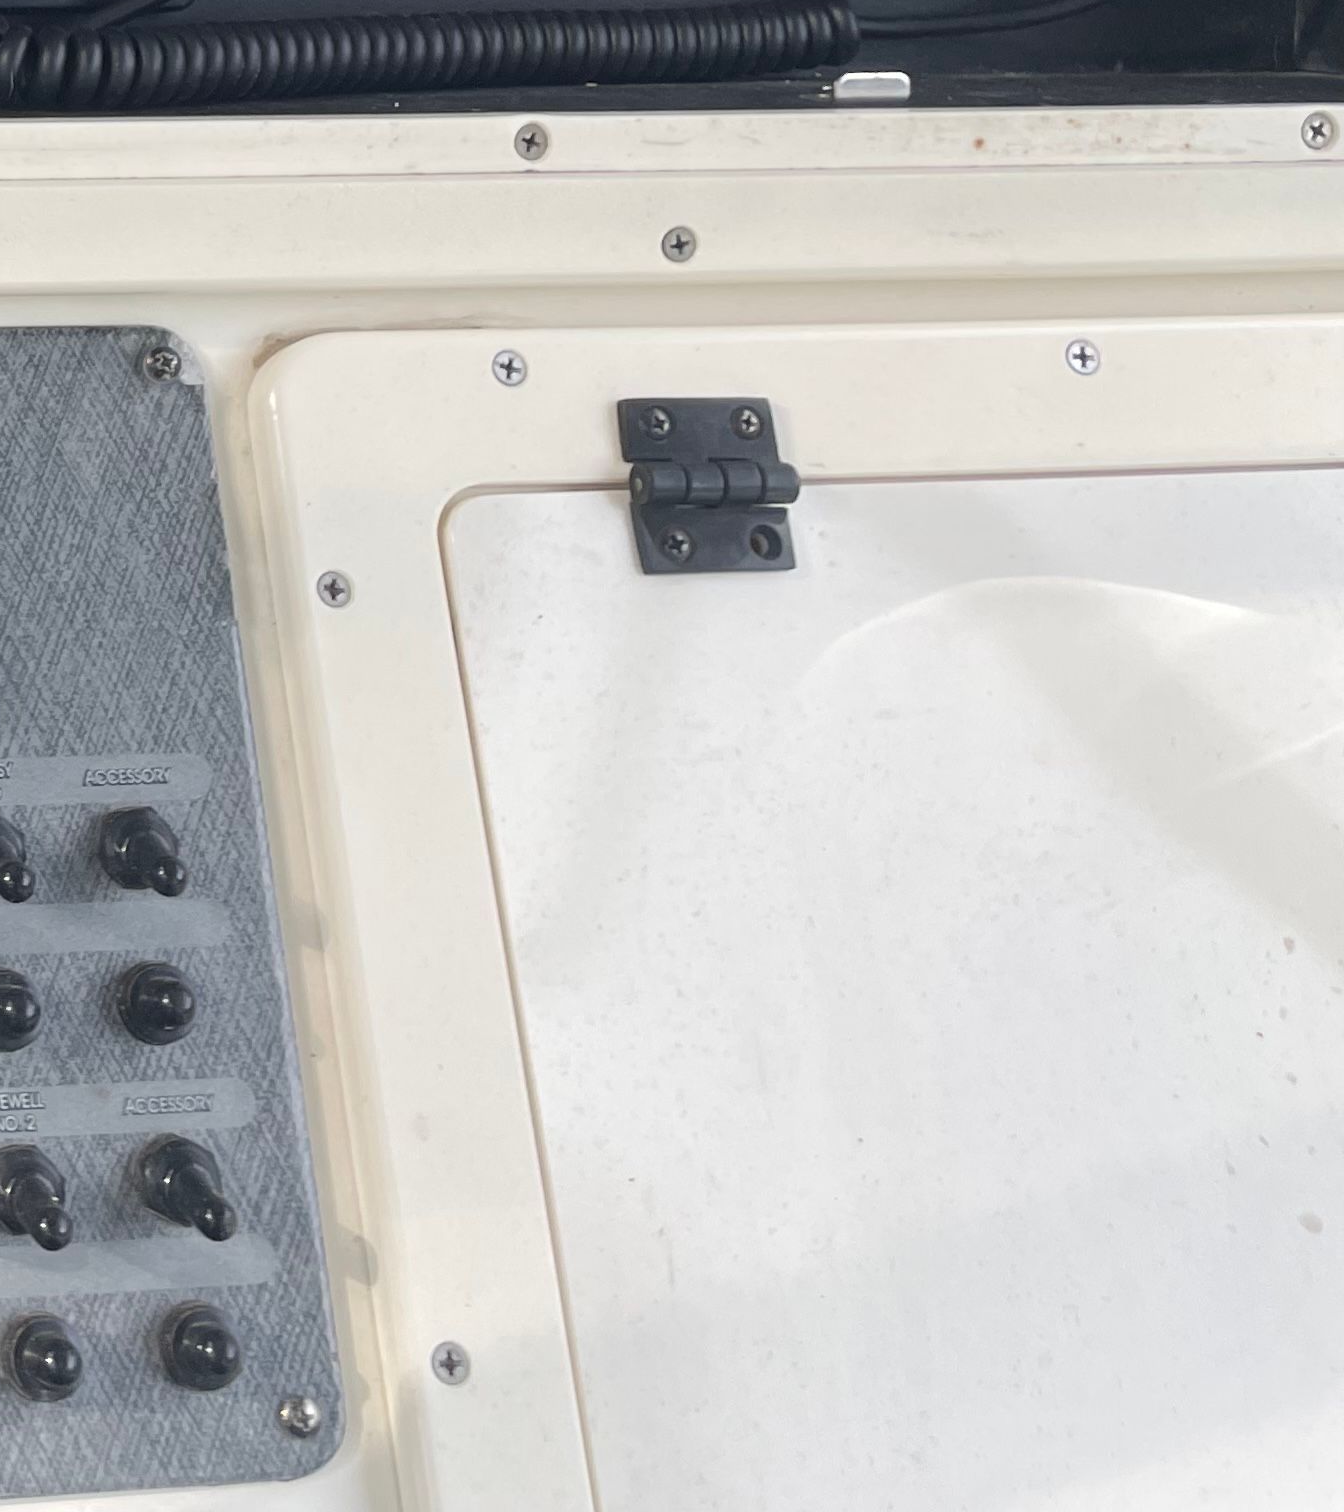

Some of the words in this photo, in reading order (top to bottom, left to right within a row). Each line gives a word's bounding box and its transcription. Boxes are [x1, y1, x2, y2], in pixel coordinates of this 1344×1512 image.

[83, 766, 173, 787] ACCESSORY
[122, 1095, 213, 1117] ACCESSORY
[23, 1114, 38, 1132] 2
